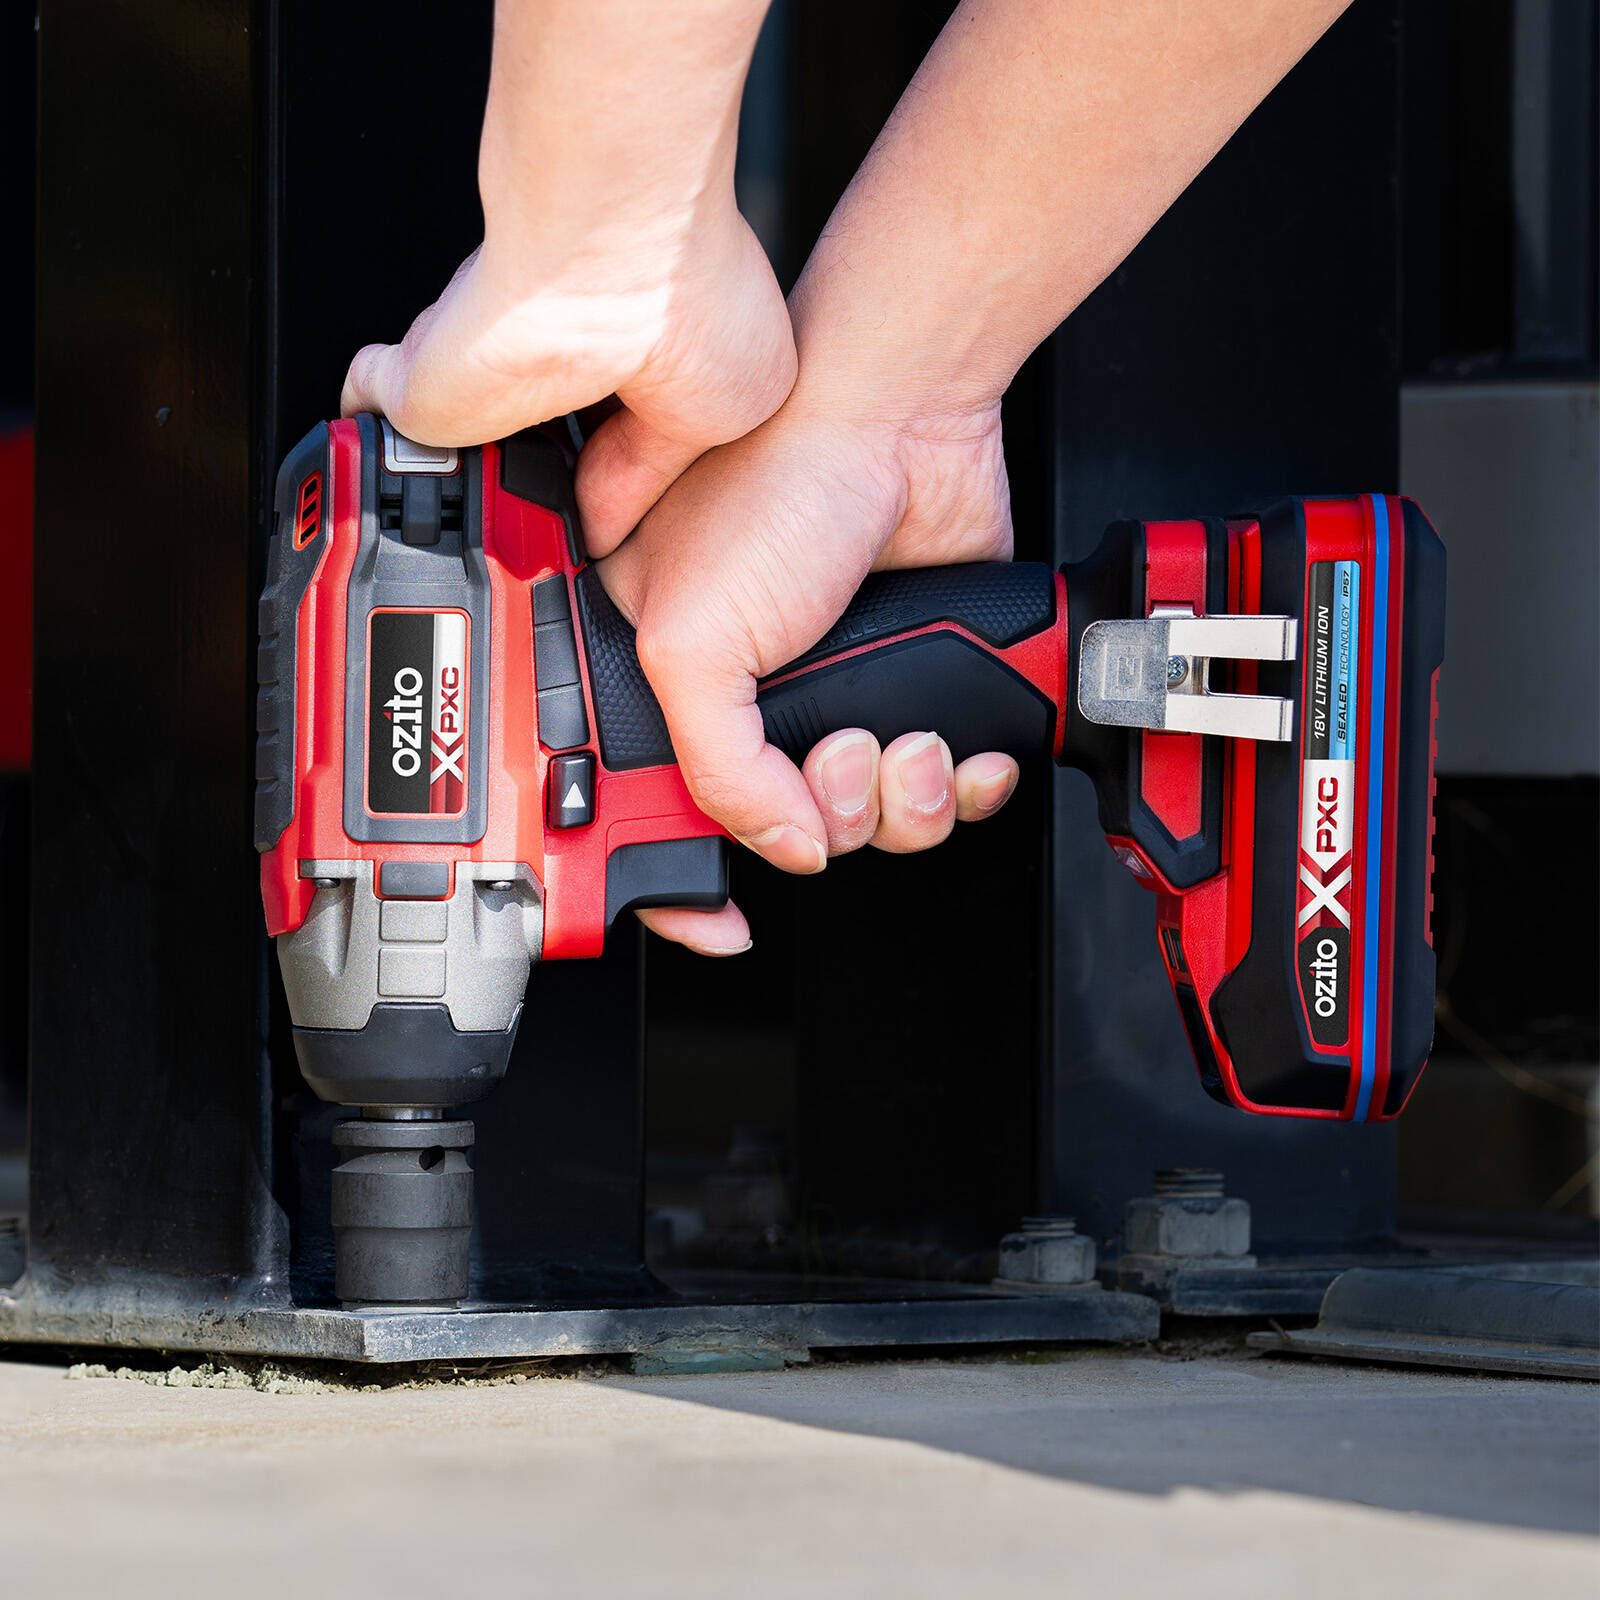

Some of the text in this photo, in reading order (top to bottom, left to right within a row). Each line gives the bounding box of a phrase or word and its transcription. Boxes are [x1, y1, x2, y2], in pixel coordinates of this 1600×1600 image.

[440, 666, 460, 733] PXC
[1313, 605, 1329, 739] 18V LITHIUM ION
[1337, 570, 1350, 740] SEALED TECHNOLOGY IP57
[383, 667, 423, 777] ozito
[1316, 777, 1339, 853] PXC
[1309, 938, 1338, 1018] ozito
